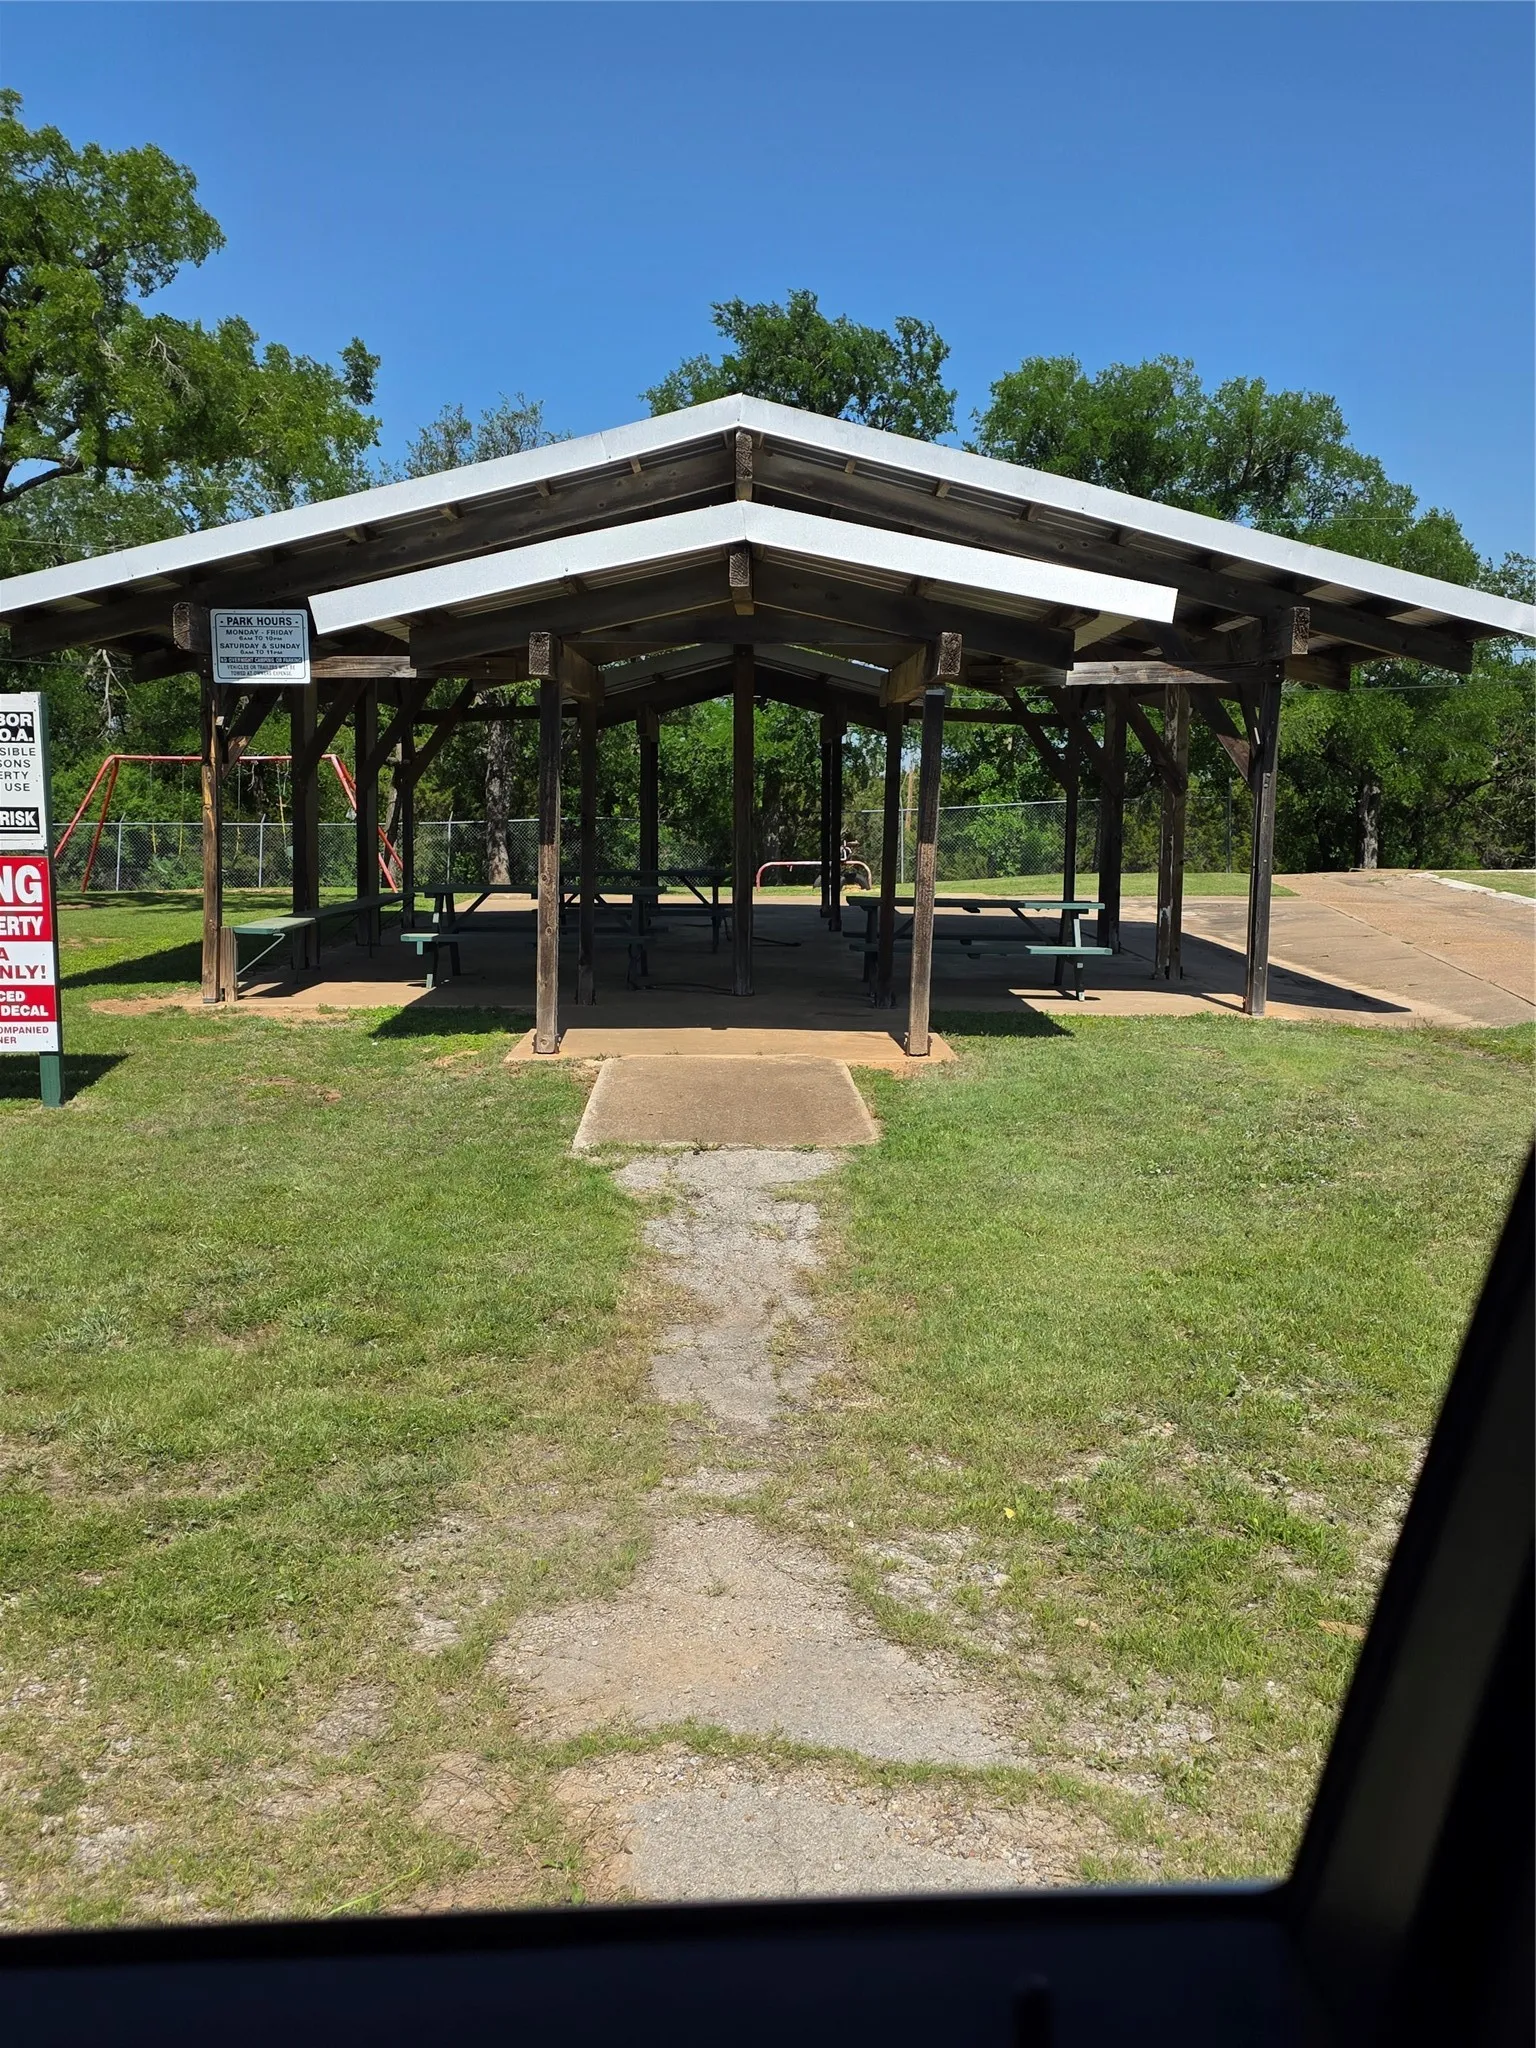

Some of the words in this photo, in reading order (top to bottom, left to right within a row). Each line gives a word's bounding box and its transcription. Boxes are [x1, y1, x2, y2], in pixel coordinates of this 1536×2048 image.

[227, 617, 253, 626] PARK
[256, 617, 292, 626] HOURS
[0, 747, 37, 756] SIBLE
[0, 759, 31, 768] ONS
[4, 782, 31, 792] USE
[0, 810, 37, 827] RISK
[0, 864, 43, 904] NG
[0, 915, 43, 936] ERTY
[0, 965, 46, 979] NLY!
[0, 1005, 49, 1017] DECAL
